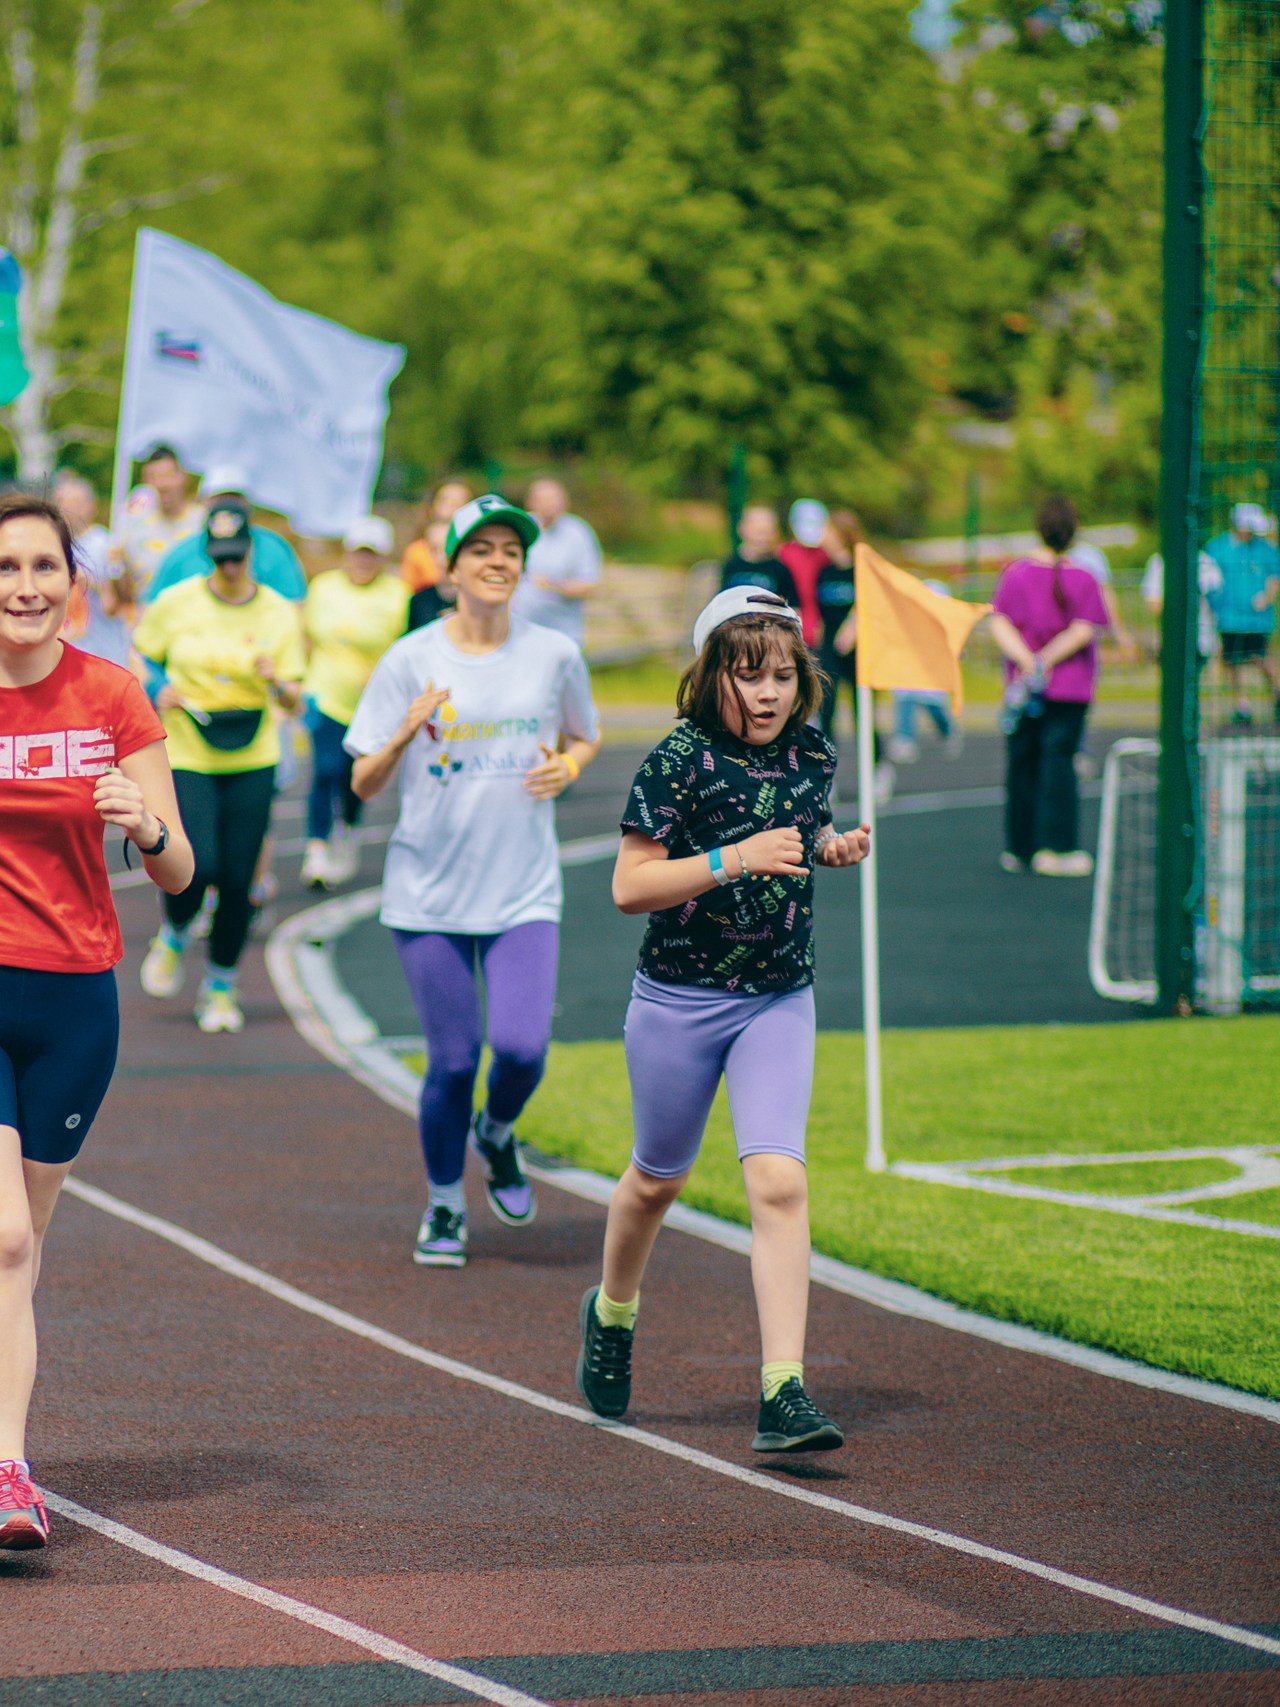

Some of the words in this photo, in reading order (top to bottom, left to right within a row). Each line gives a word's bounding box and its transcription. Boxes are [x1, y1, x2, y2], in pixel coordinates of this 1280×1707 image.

[633, 785, 645, 801] NOT
[699, 779, 729, 800] PUNK
[790, 778, 813, 798] PUNK
[638, 802, 654, 828] TODAY
[663, 936, 693, 948] PUNK
